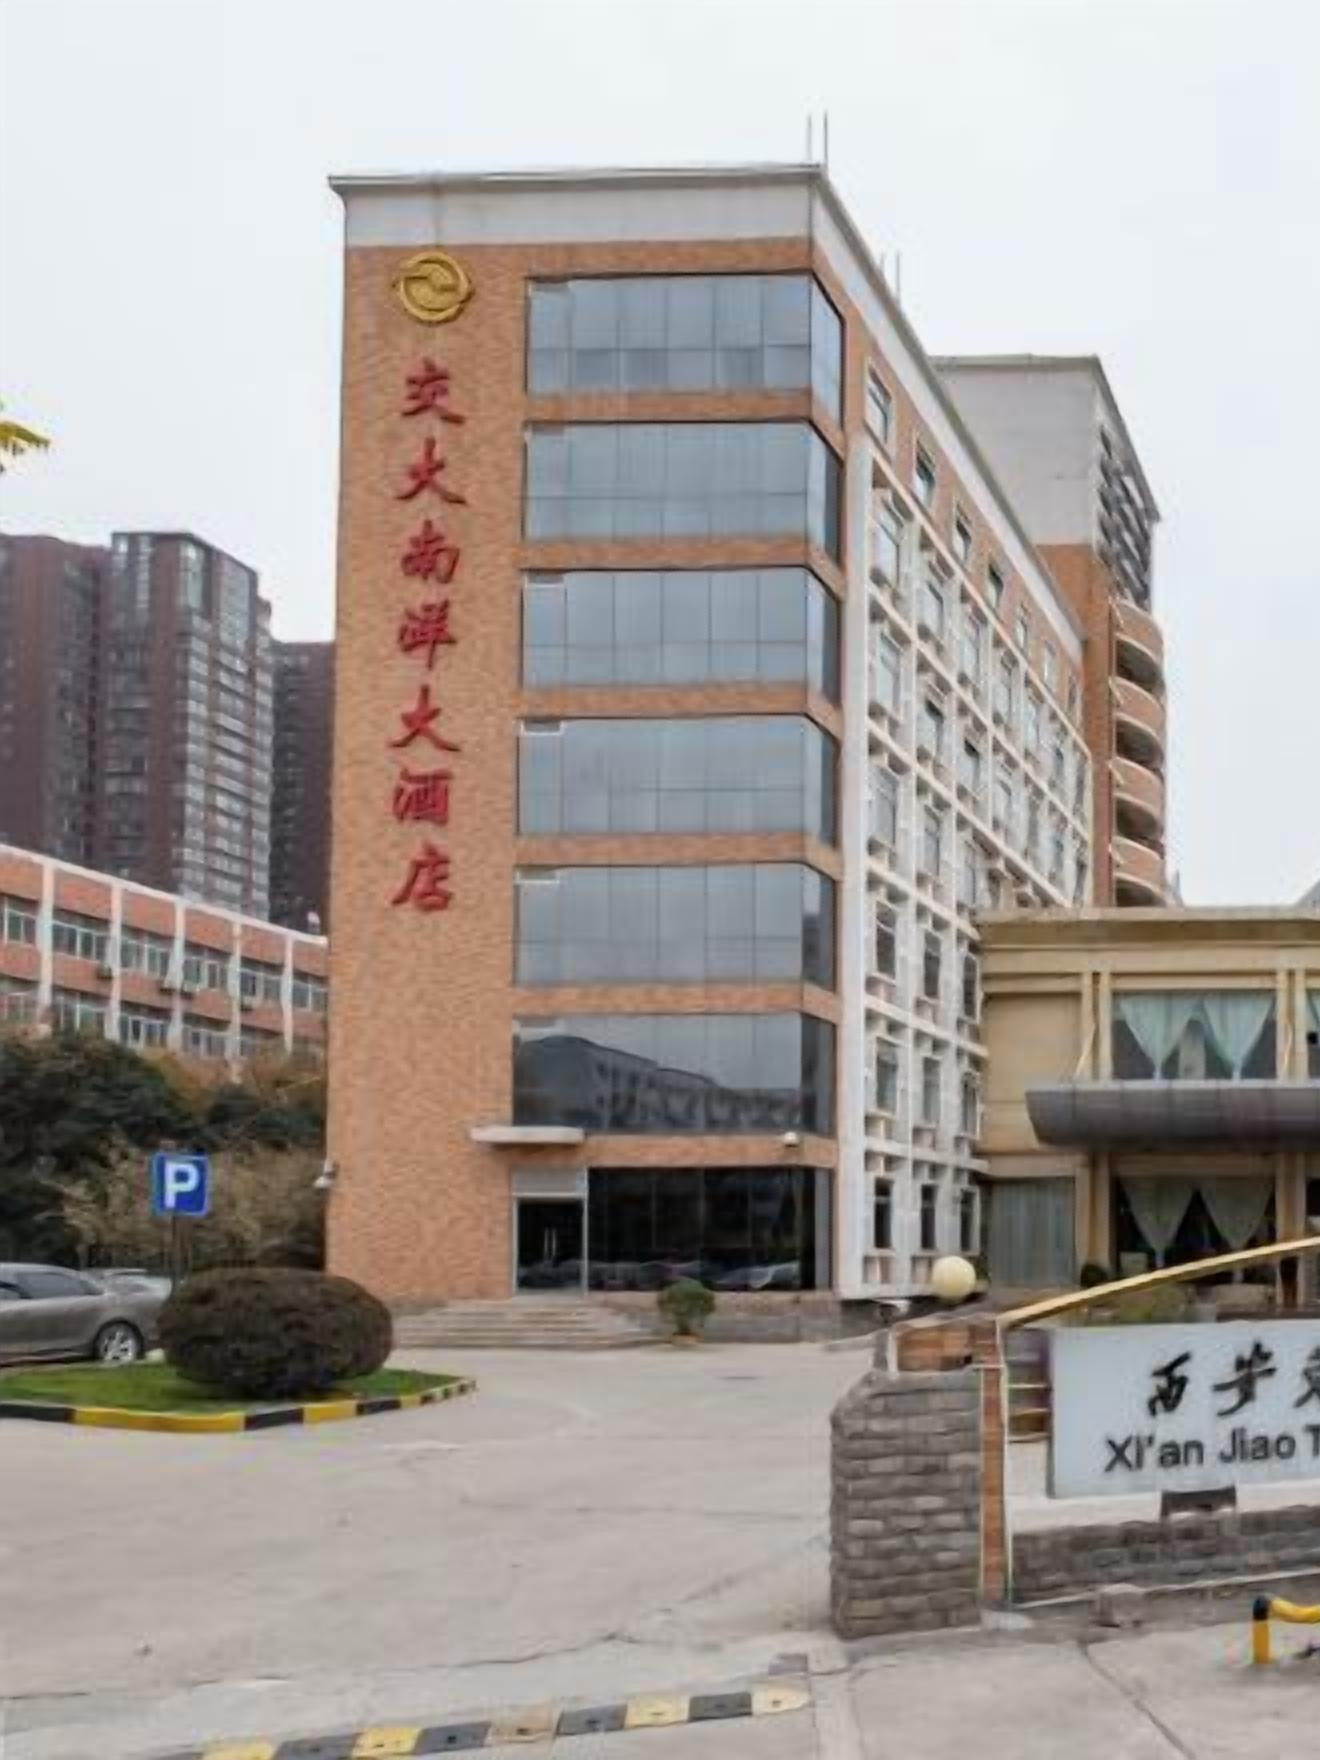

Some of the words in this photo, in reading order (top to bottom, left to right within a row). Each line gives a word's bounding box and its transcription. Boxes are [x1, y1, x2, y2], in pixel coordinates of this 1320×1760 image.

[392, 356, 468, 912] 交大南洋大酒店
[164, 1161, 199, 1208] P
[1104, 1434, 1204, 1473] Xi'an
[1218, 1427, 1297, 1464] Jiao
